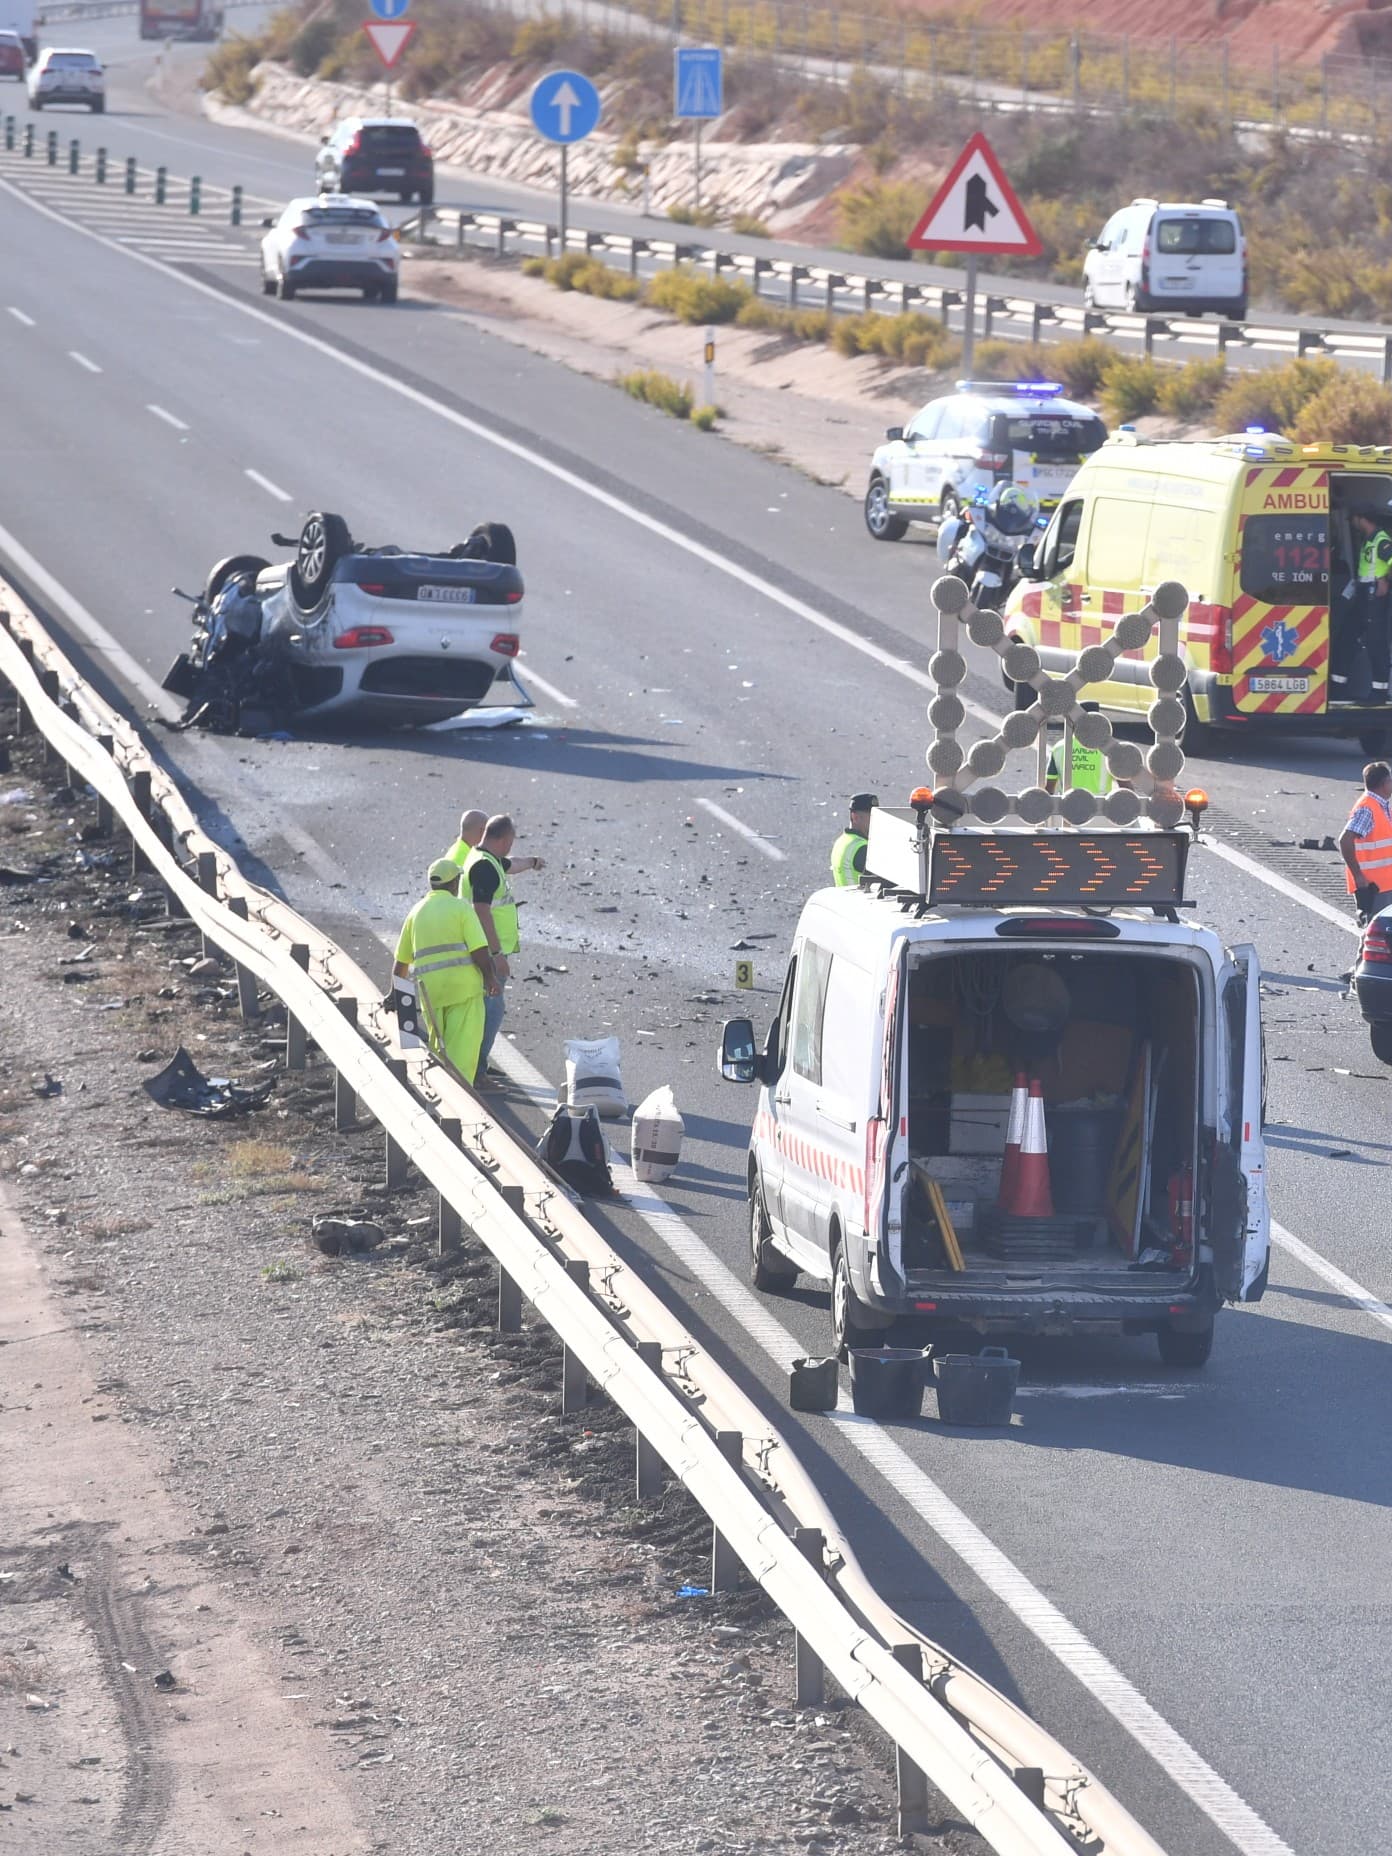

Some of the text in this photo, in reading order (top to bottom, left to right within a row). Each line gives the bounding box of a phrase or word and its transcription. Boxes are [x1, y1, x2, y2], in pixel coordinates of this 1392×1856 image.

[1257, 679, 1306, 690] 5864 LGB
[738, 964, 748, 983] 3
